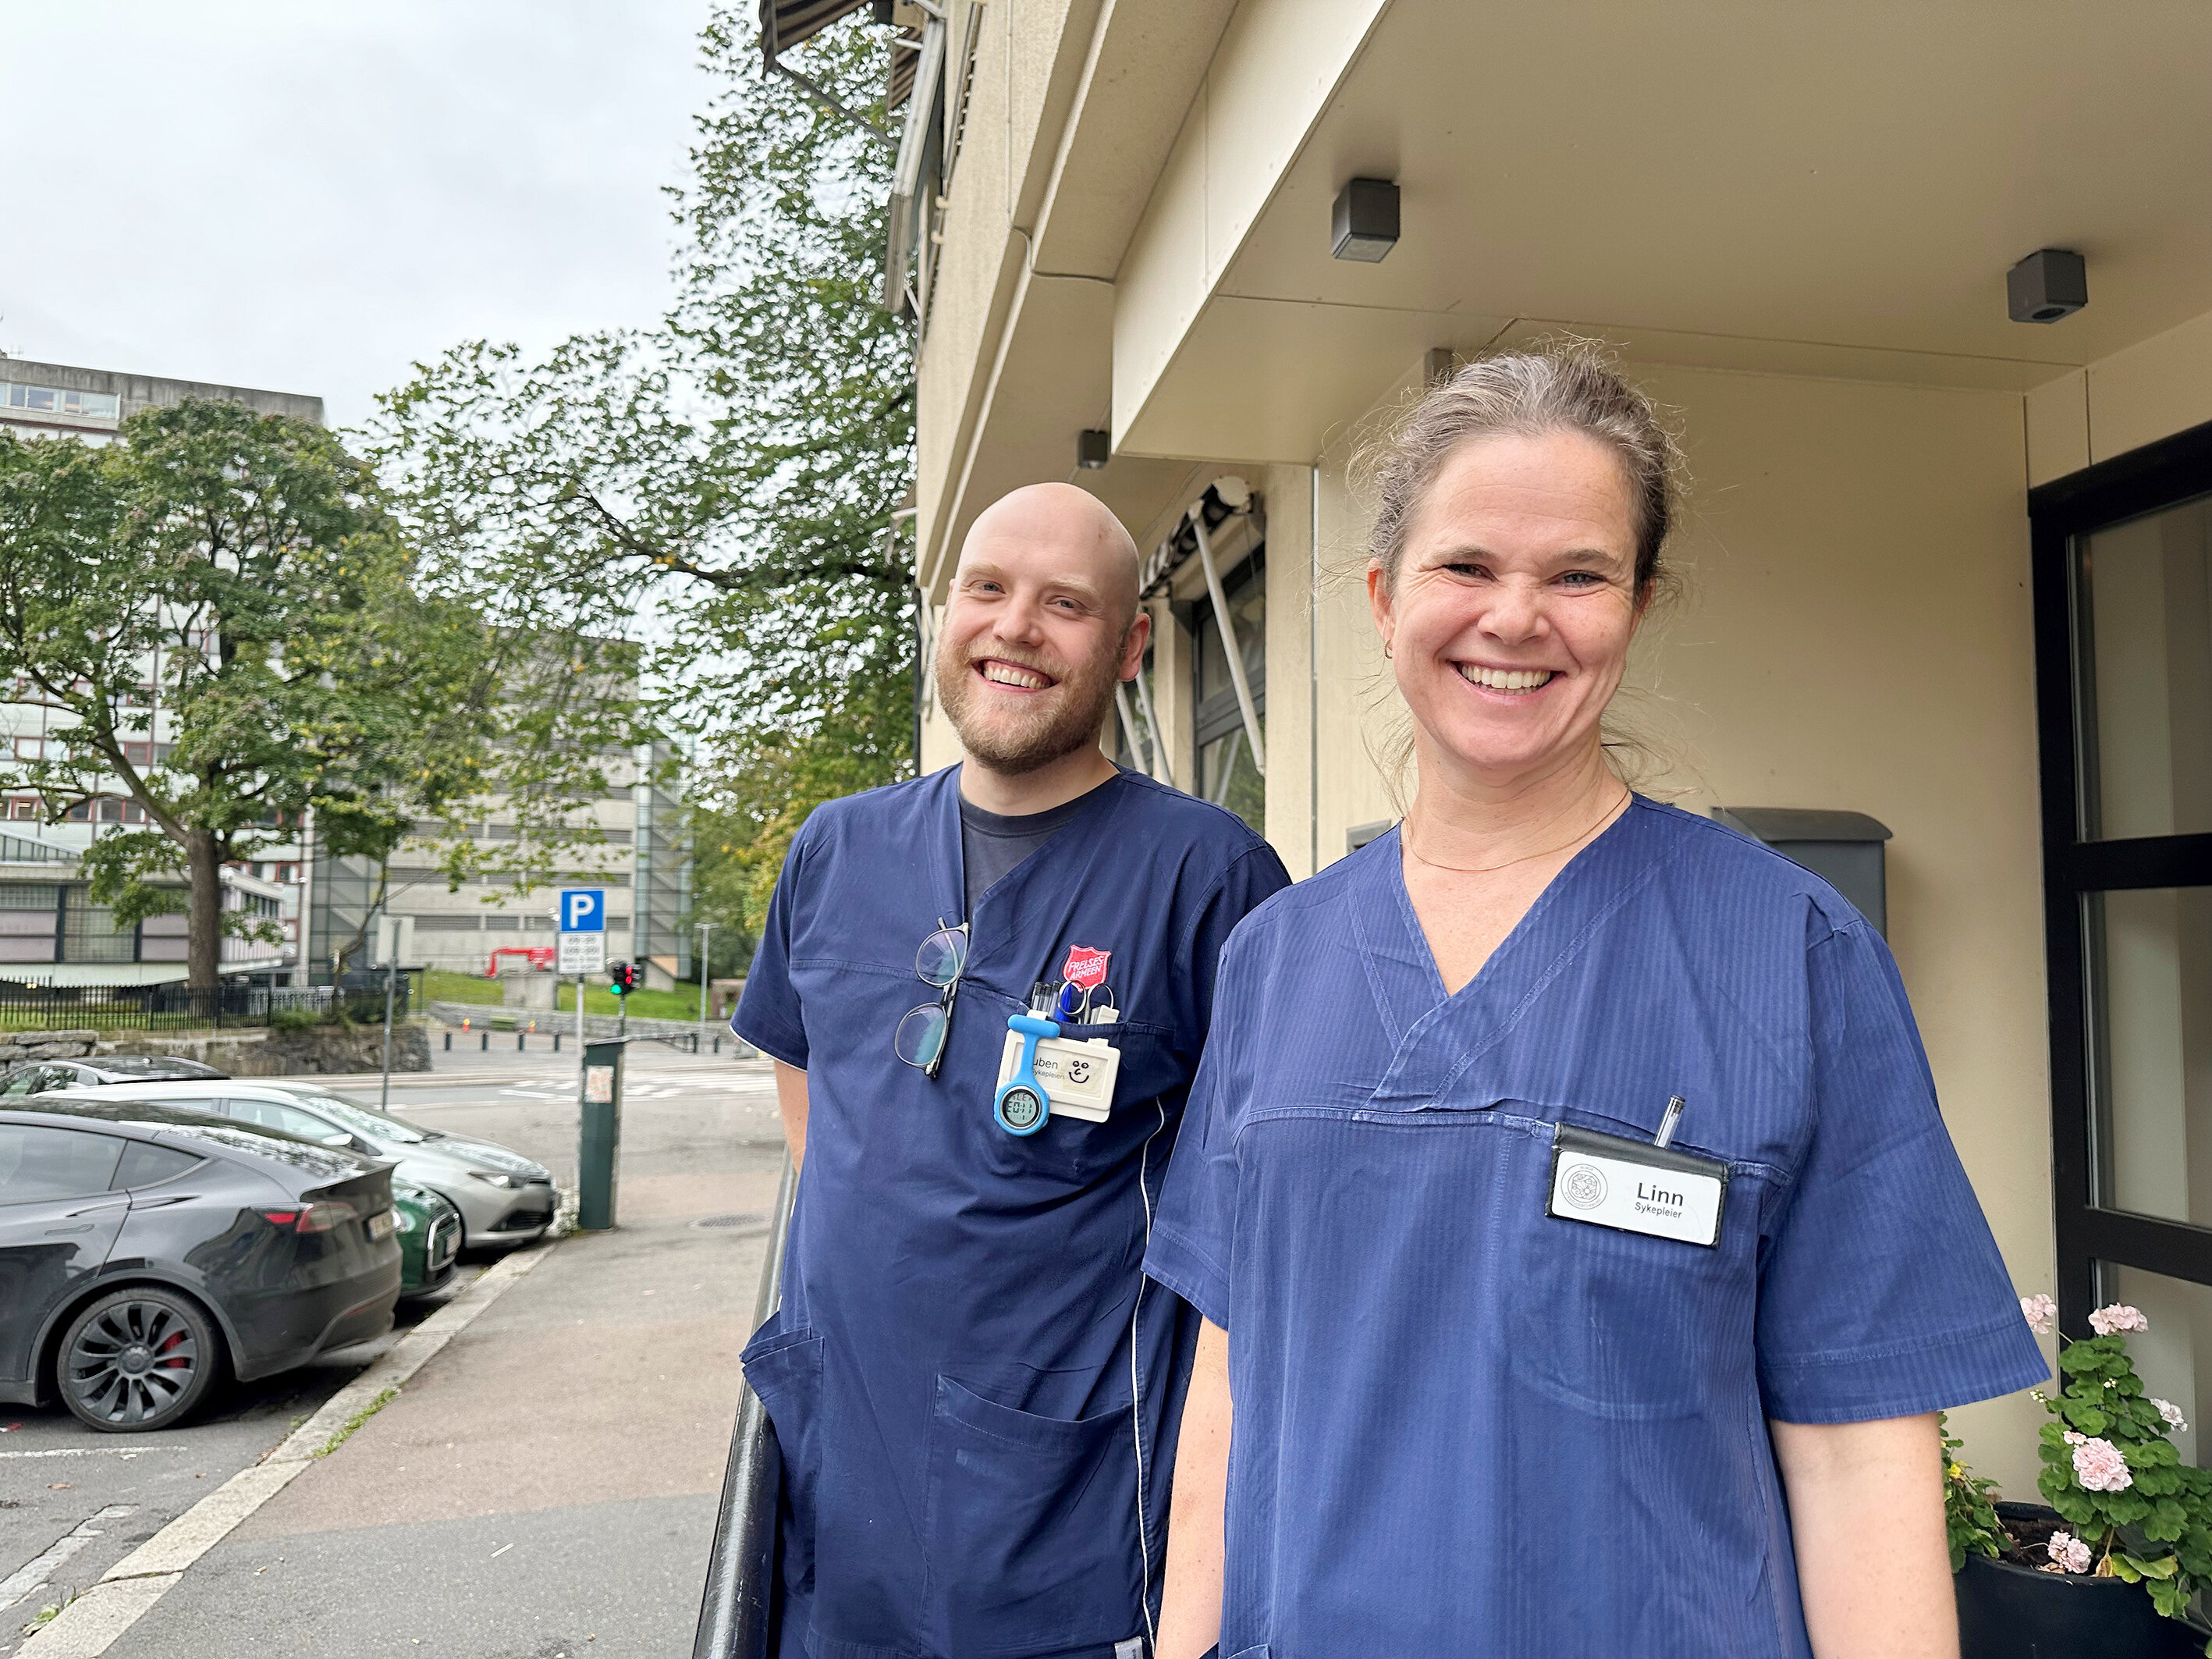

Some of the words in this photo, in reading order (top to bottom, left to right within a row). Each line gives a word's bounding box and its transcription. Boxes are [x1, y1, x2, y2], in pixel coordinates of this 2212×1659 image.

[570, 893, 595, 929] P
[1068, 955, 1104, 974] FRELSES
[1070, 965, 1102, 980] ARMEEN
[1032, 1057, 1059, 1070] uben
[1637, 1182, 1684, 1206] Linn
[1635, 1202, 1682, 1218] Sykepleier
